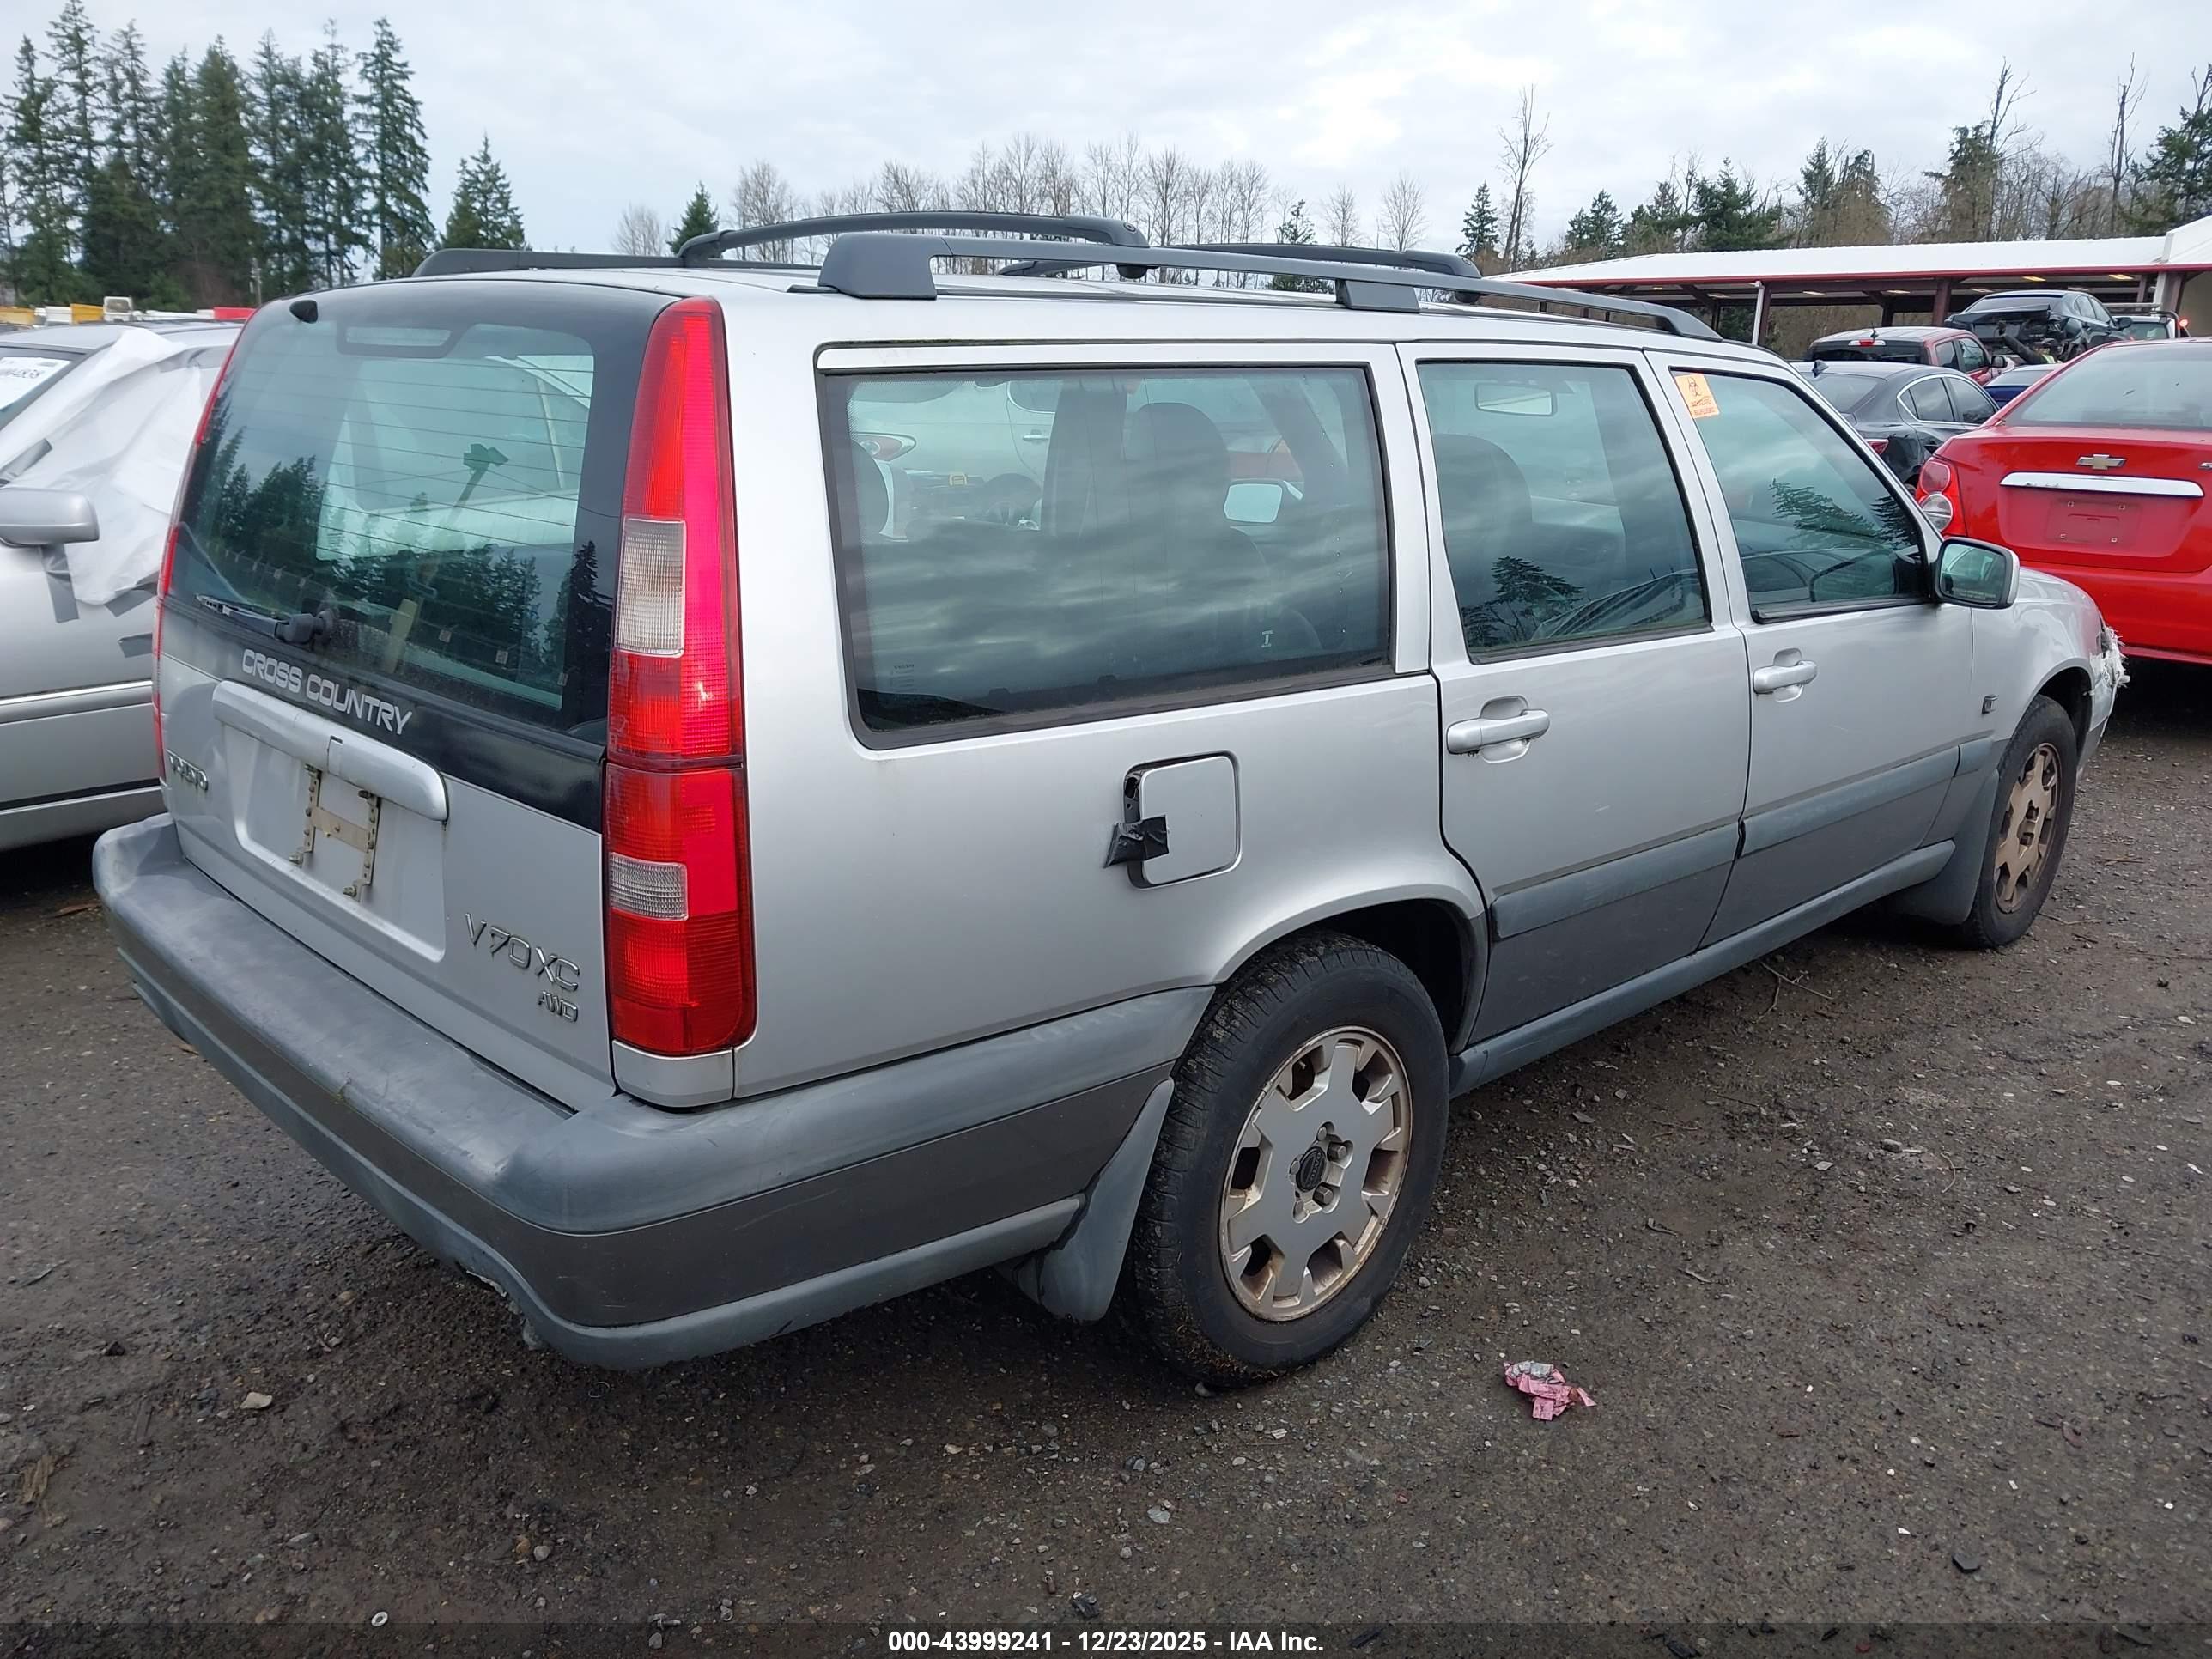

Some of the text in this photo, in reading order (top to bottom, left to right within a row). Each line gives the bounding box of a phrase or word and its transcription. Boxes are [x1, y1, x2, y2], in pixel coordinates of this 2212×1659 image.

[241, 648, 413, 735] CROSS COUNTRY
[538, 990, 579, 1023] AWD
